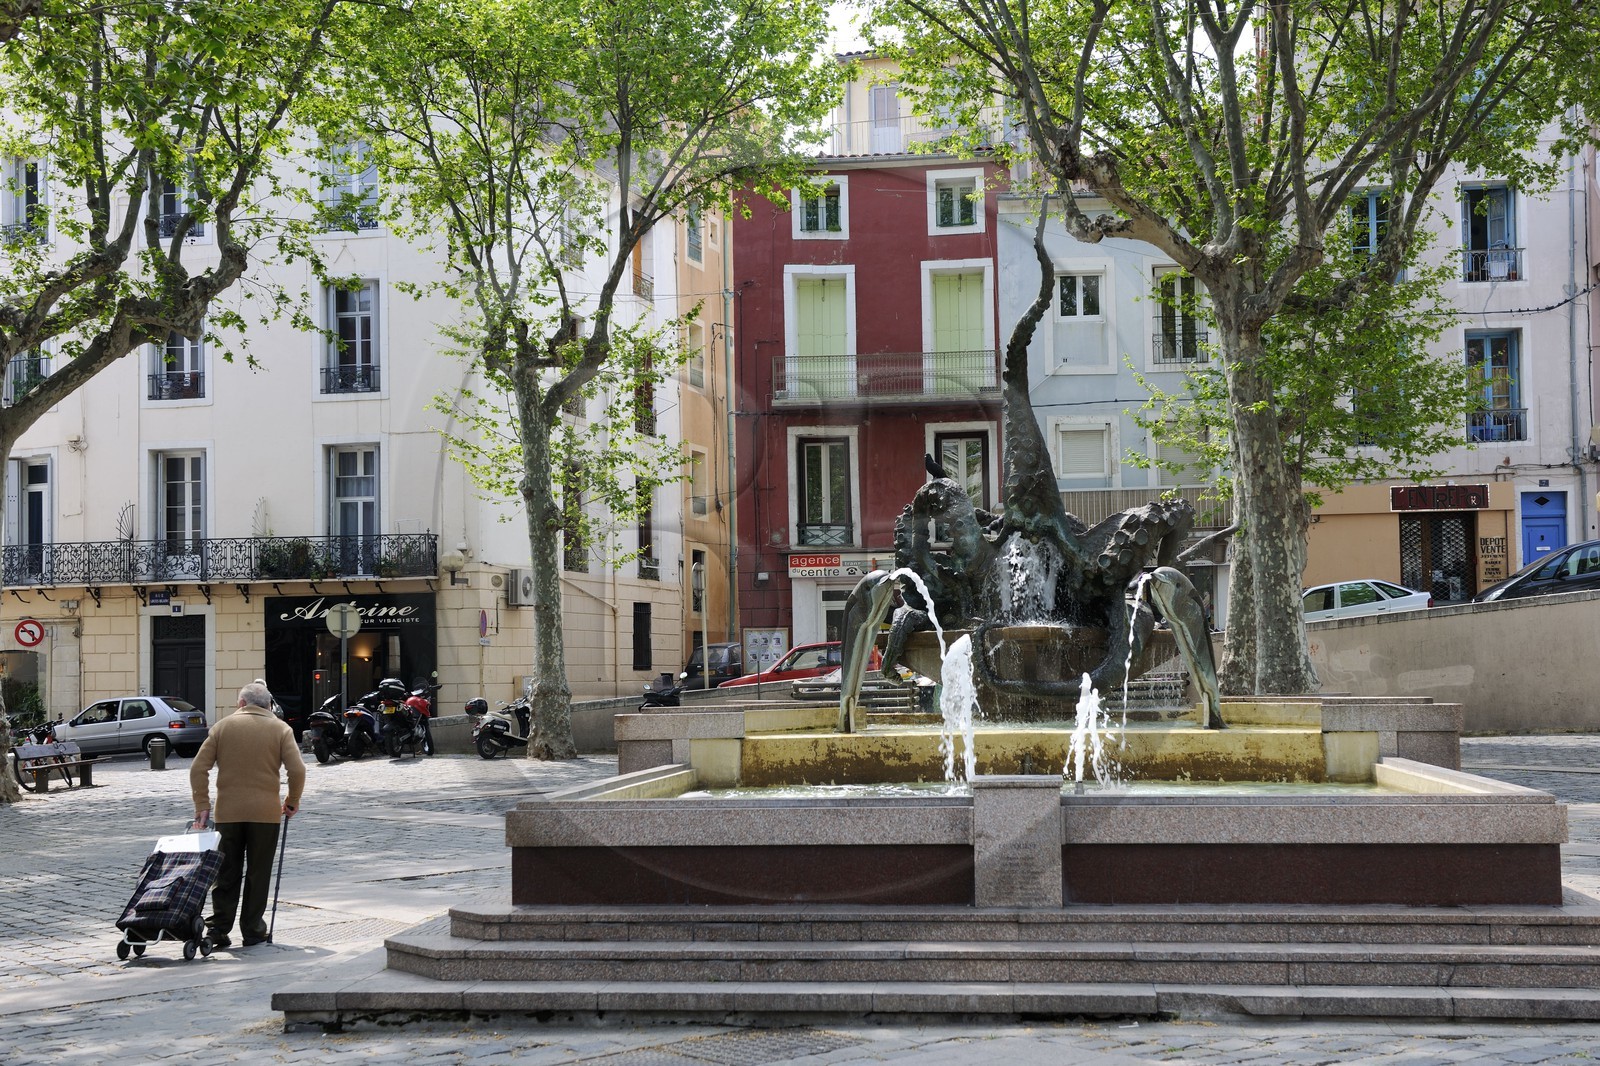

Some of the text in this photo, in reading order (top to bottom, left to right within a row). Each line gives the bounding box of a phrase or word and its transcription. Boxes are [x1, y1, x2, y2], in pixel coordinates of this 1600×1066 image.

[792, 556, 839, 566] agence
[800, 567, 840, 577] centre
[280, 597, 419, 620] Aoine
[378, 617, 421, 625] VISAGISTE
